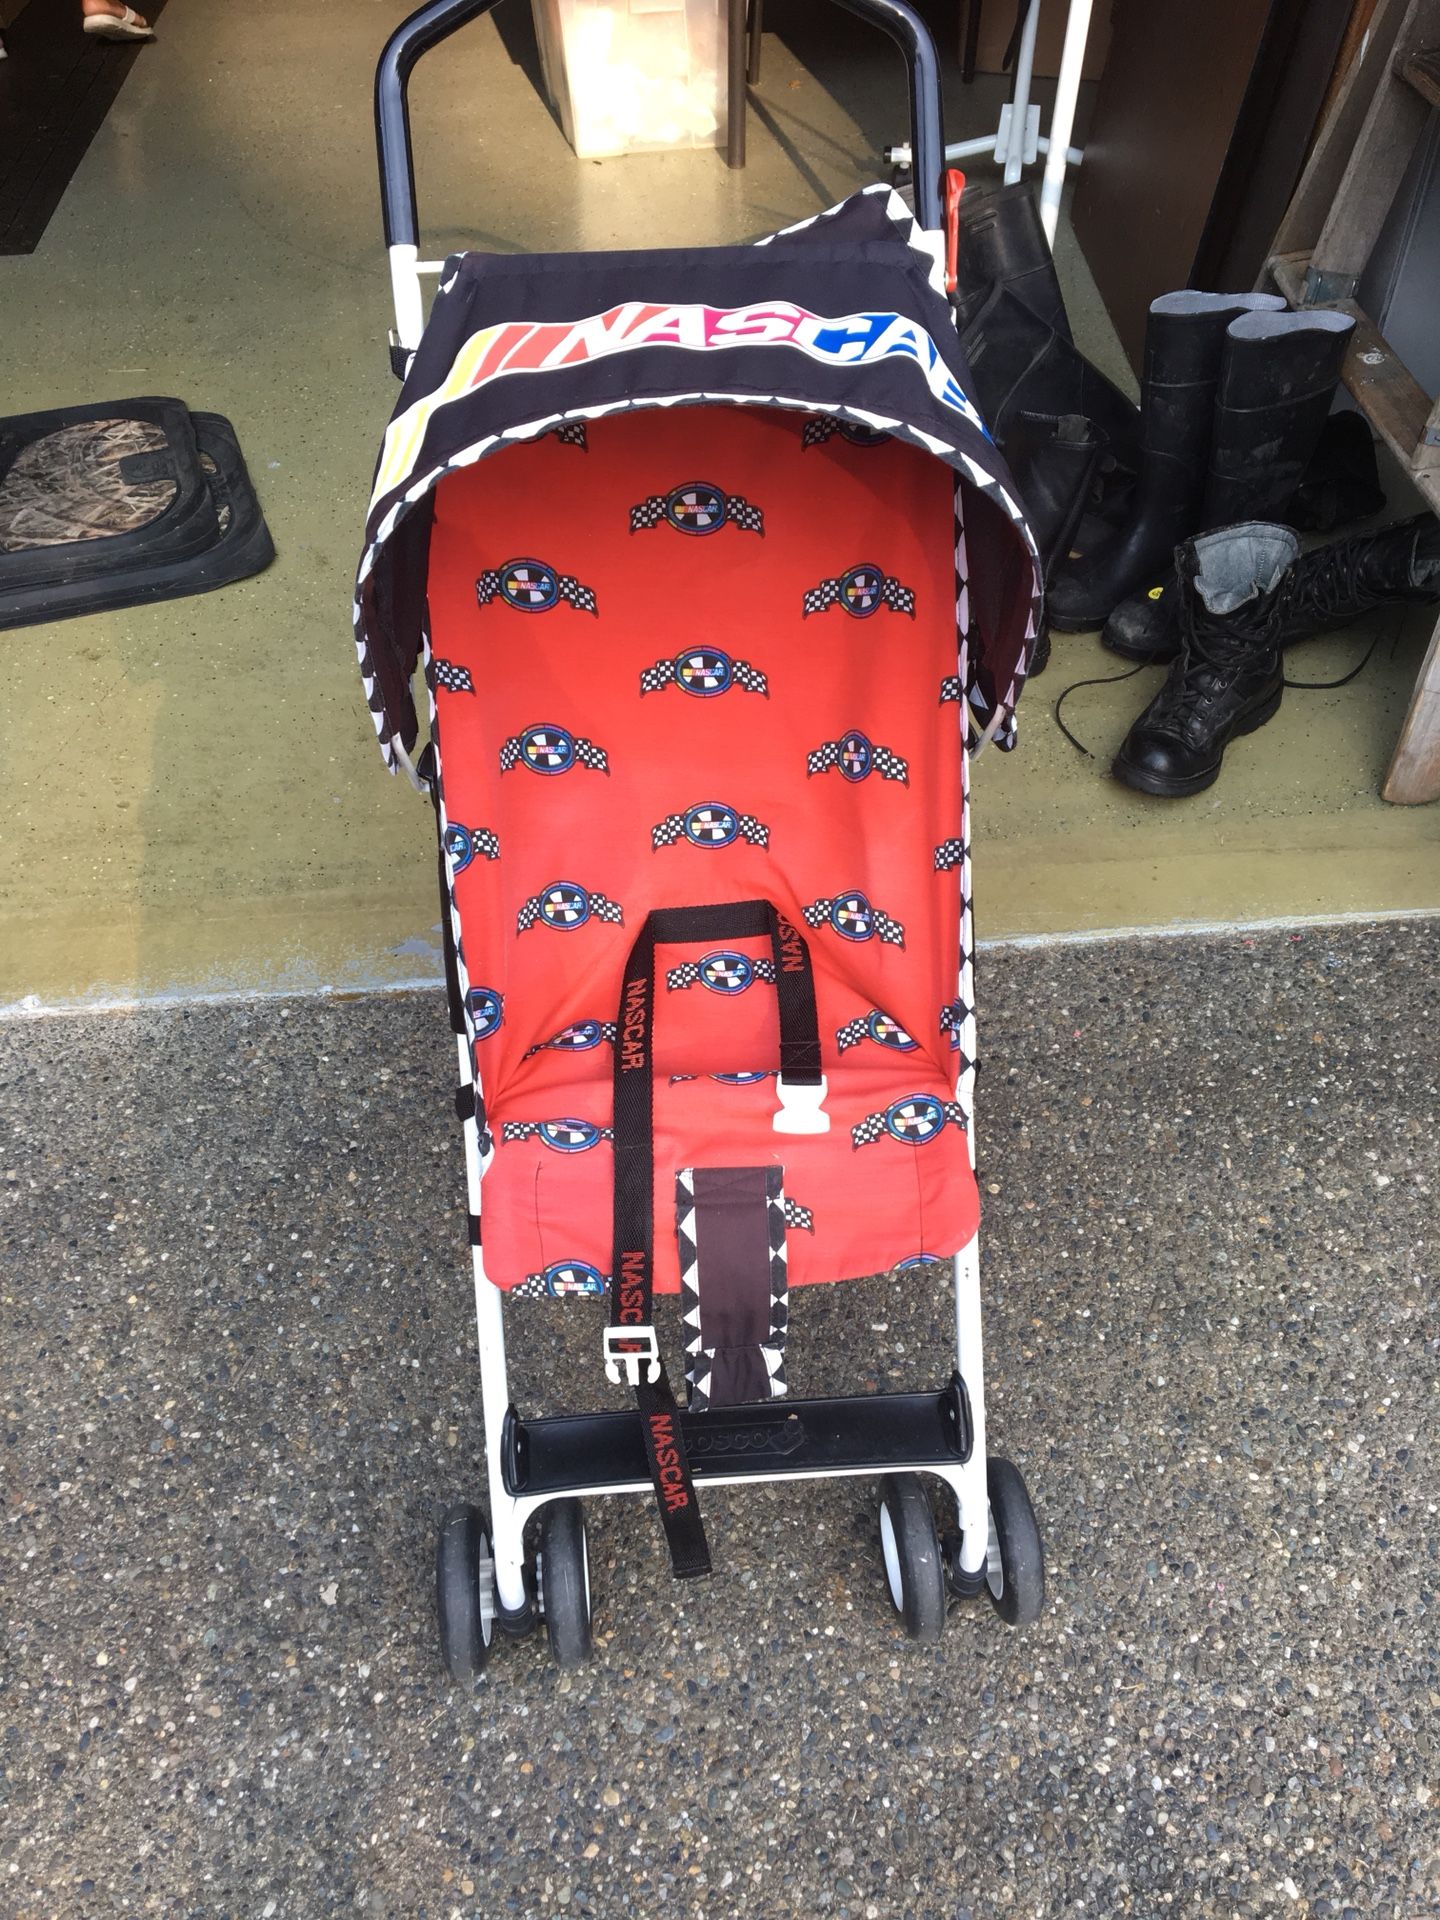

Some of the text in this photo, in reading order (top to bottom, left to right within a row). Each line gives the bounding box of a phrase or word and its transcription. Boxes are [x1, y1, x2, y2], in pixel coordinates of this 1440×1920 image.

[687, 505, 718, 513] NASCAR
[519, 581, 551, 591] NASCAR
[695, 667, 723, 677] NASCAR
[539, 745, 568, 754] NASCAR
[703, 820, 732, 829] NASCAR
[556, 902, 582, 910] NASCAR
[718, 968, 746, 976] NASCAR
[620, 977, 648, 1070] NASCAR
[908, 1112, 938, 1126] NASCAR
[567, 1282, 598, 1291] NASCAR
[649, 1413, 689, 1513] NASCAR
